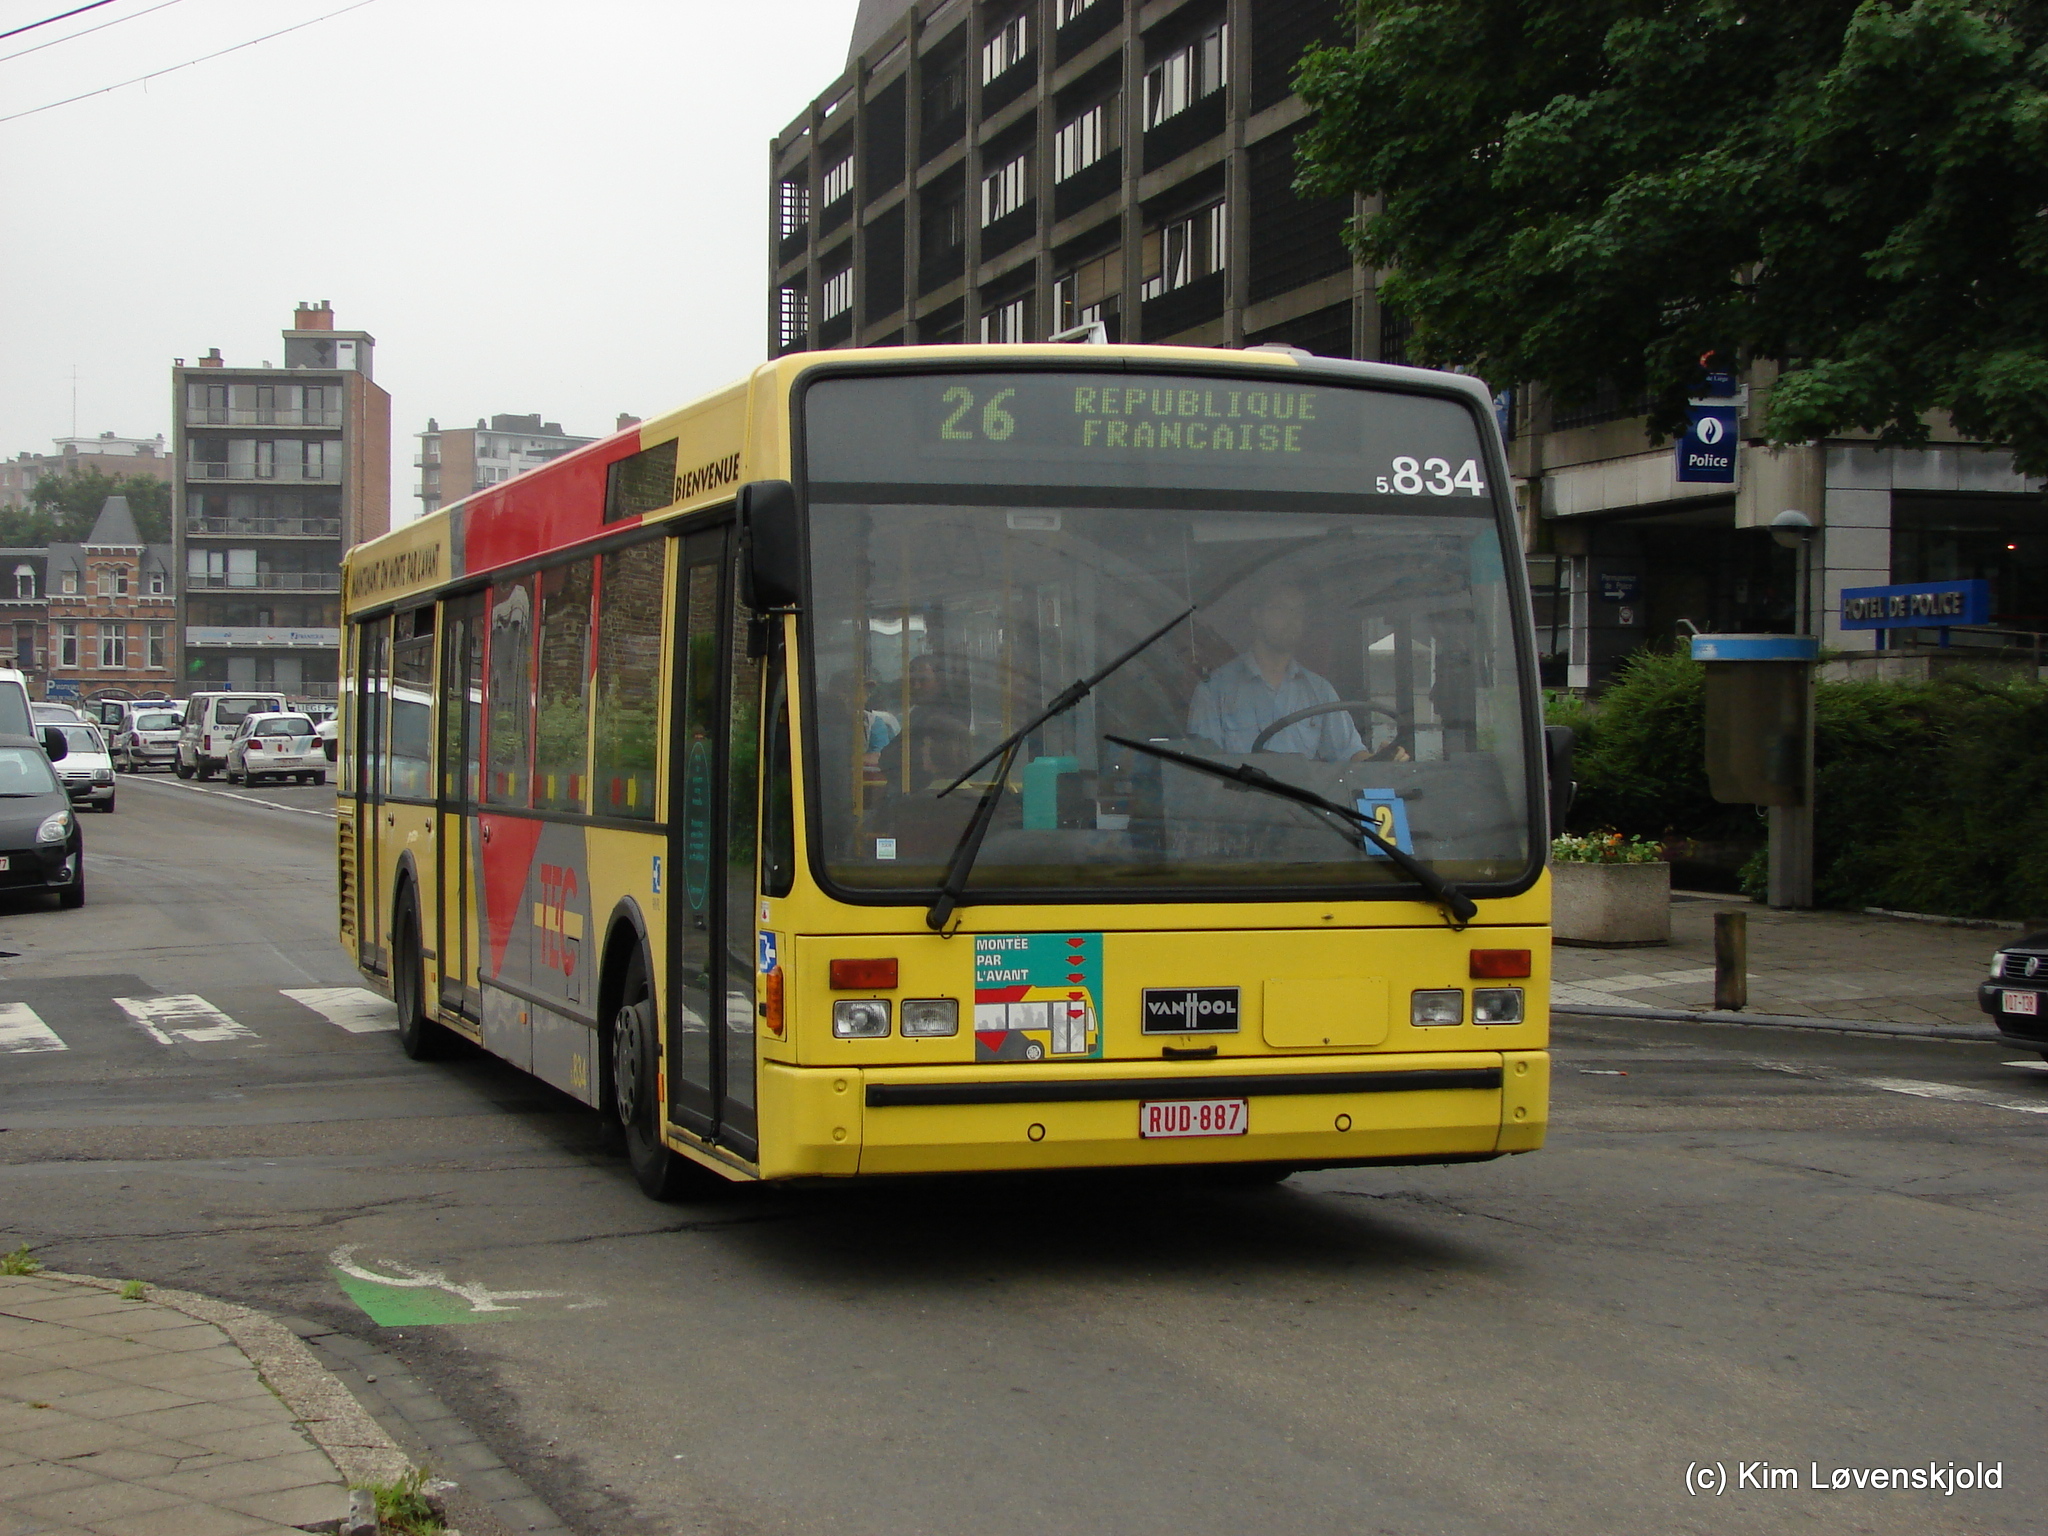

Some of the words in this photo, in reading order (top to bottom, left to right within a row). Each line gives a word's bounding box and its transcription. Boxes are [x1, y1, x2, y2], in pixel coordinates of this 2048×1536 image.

[941, 386, 1015, 442] 26
[1075, 386, 1317, 421] REPUBLIQUE
[1082, 419, 1302, 453] FRANCAISE
[1375, 455, 1485, 496] 5.834
[1688, 453, 1729, 468] Police
[675, 452, 741, 503] BIENVENUE
[1843, 597, 1884, 620] HOTEL
[1888, 596, 1905, 617] DE
[1910, 591, 1965, 616] POLICE
[46, 680, 56, 694] P
[297, 704, 322, 712] LIEGE
[1375, 805, 1397, 847] 2
[539, 862, 578, 978] TEC
[976, 936, 1029, 951] MONTÉE
[976, 954, 1002, 967] PAR
[976, 969, 1029, 983] L'AVANT
